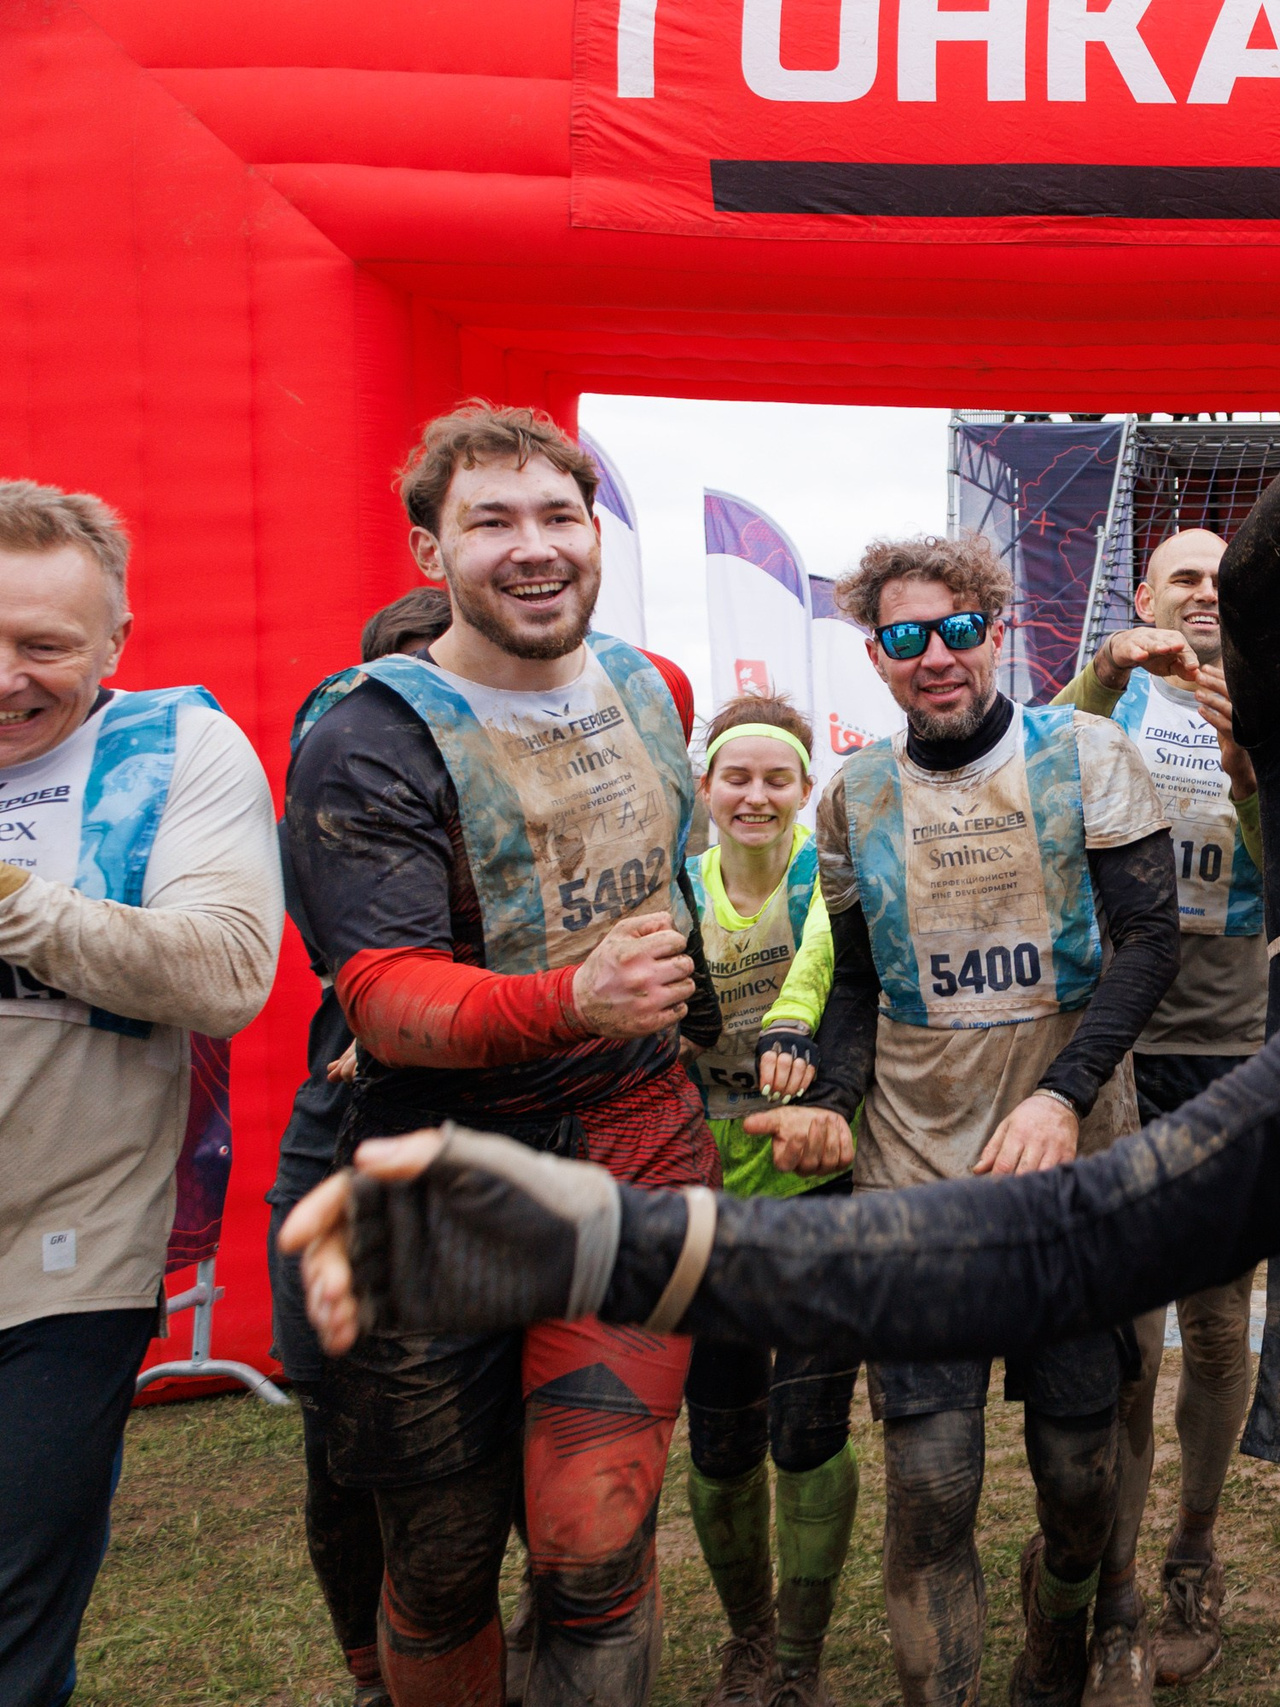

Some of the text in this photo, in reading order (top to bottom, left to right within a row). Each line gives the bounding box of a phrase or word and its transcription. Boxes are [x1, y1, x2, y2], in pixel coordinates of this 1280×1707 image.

[568, 705, 621, 735] ГЕРОЕВ
[1146, 726, 1218, 745] ГОНКА ГЕР
[537, 744, 623, 786] Sminex
[1155, 747, 1224, 773] Sminex
[1151, 772, 1224, 789] ПЕРФЕКЦИОНИСТЫ
[1168, 784, 1222, 798] DEVELOPMENT
[580, 783, 637, 812] DEVELOPMENT
[912, 810, 1026, 840] ГОНКА ГЕРОЕВ
[928, 844, 1013, 870] Sminex
[1180, 840, 1223, 882] 10
[558, 846, 665, 932] 5402
[930, 870, 1017, 889] ПЕРФЕКЦИОНИСТЫ
[932, 881, 1018, 900] FINE DEVELOPMENT
[740, 944, 790, 969] ГЕРОЕВ
[930, 942, 1041, 997] 5400
[714, 976, 778, 1004] minex
